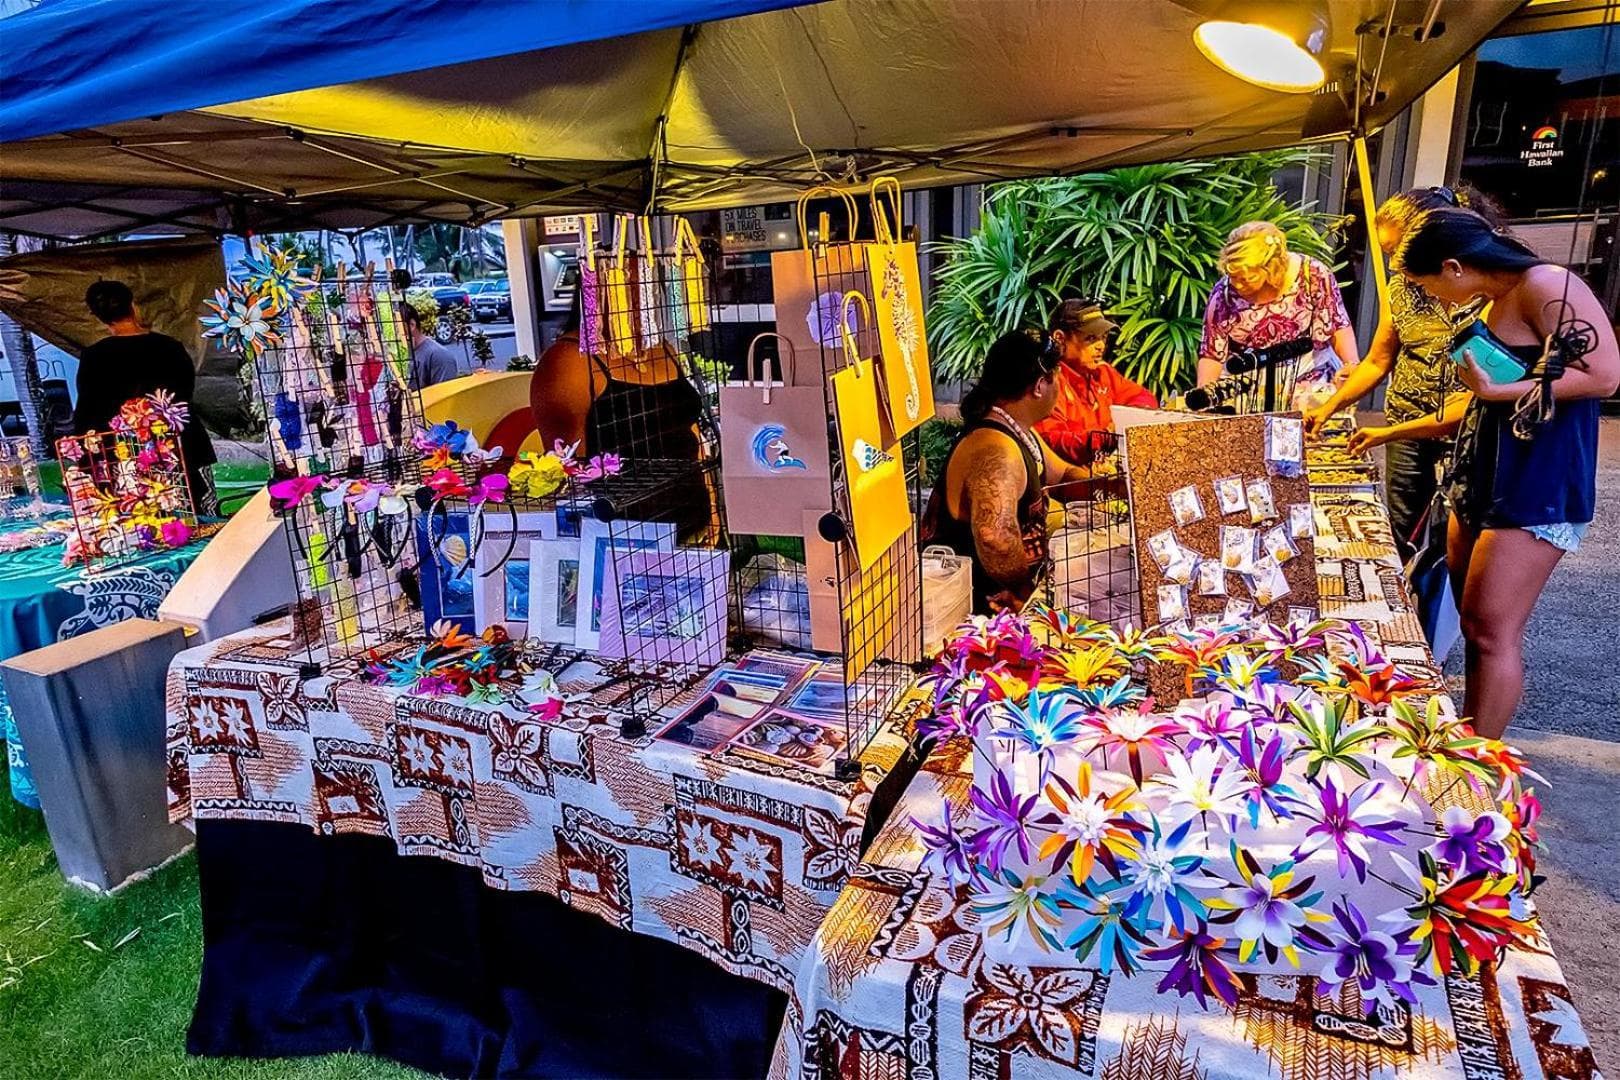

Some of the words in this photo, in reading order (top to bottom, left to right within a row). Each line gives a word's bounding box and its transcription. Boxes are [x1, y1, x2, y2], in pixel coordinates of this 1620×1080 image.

[1532, 141, 1554, 149] First
[1520, 149, 1564, 159] Hawaiian
[1528, 158, 1553, 167] Bank
[737, 219, 763, 231] TRAVEL
